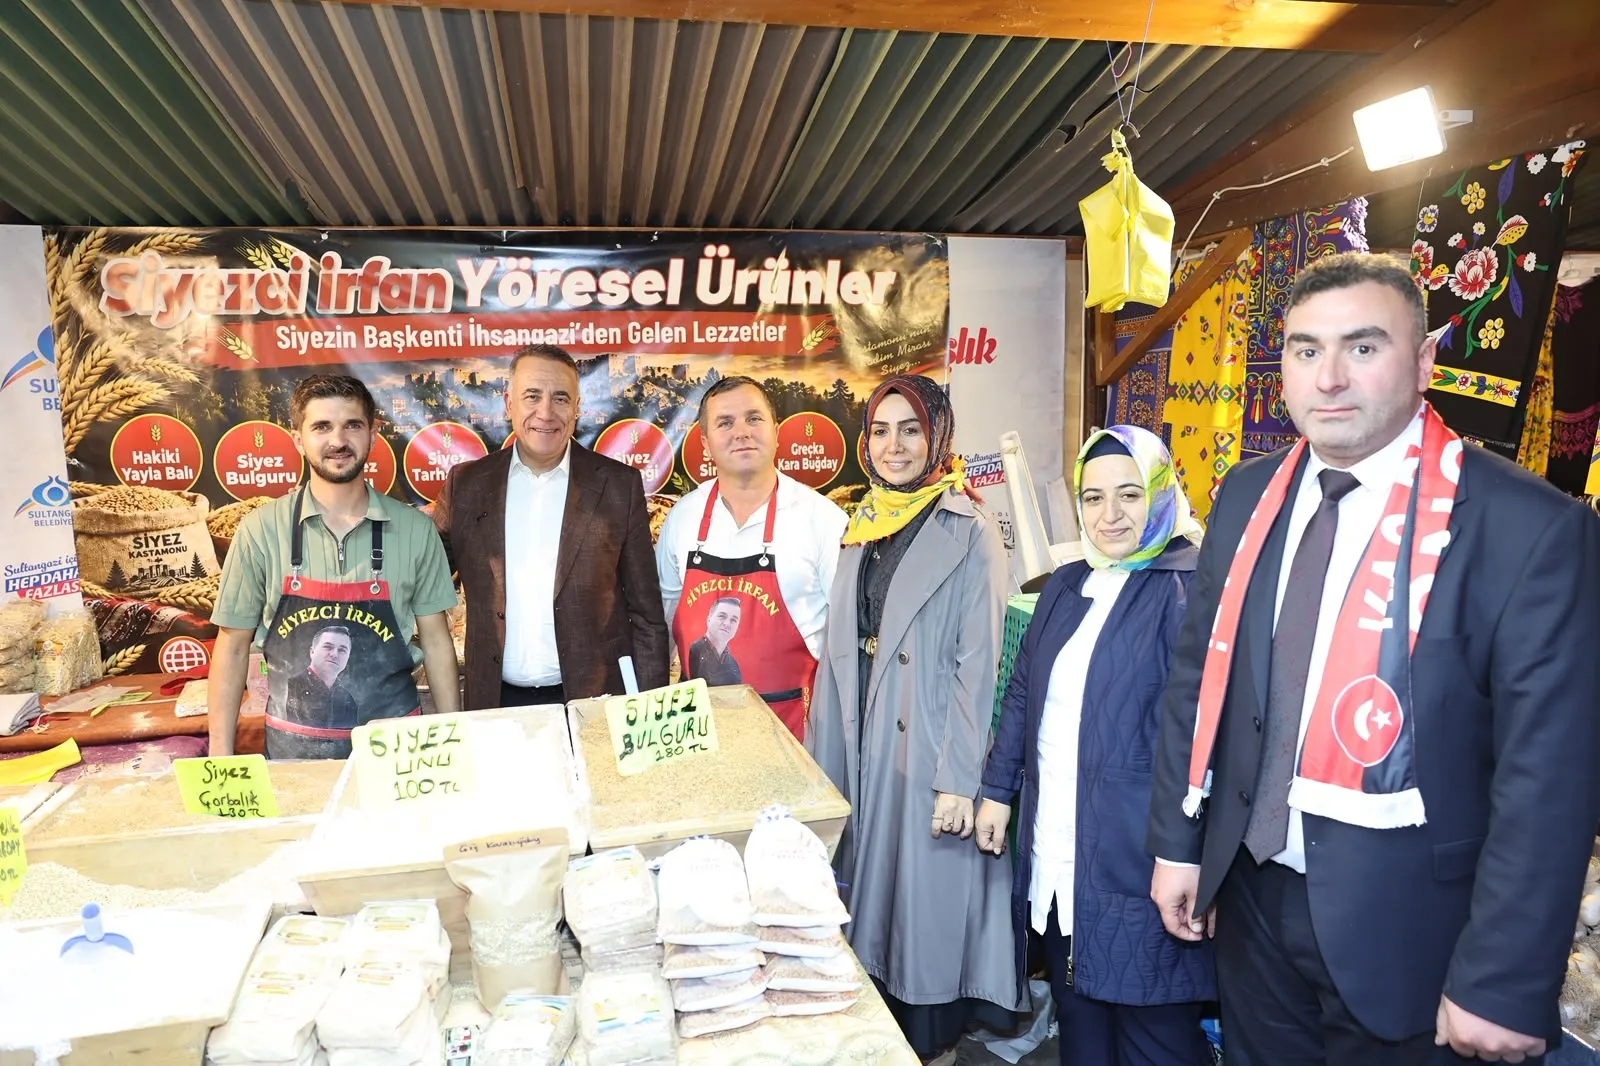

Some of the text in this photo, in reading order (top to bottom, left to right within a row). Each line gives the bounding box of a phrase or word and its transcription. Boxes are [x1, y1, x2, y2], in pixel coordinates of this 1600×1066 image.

[99, 250, 309, 329] Siyezci
[456, 256, 685, 308] Yöresel
[696, 243, 898, 305] Ürünler
[276, 325, 357, 355] Siyezin
[363, 323, 463, 353] Başkenti
[627, 321, 687, 344] Gelen
[693, 320, 787, 343] Lezzetler
[132, 448, 181, 465] Hakiki
[237, 453, 284, 472] Siyez
[778, 457, 838, 473] Kara Buğday
[121, 466, 194, 484] Yayla Balı
[226, 471, 297, 488] Bulguru
[132, 532, 182, 549] SİYEZ
[129, 545, 188, 559] KASTAMONU
[4, 556, 62, 577] Sultangazi
[686, 576, 779, 616] SİYEZCİ İRFAN
[277, 603, 395, 642] SİYEZCİ İRFAN
[619, 715, 708, 760] BULGURU
[689, 743, 708, 753] TL
[202, 760, 251, 787] Siyez
[396, 753, 451, 775] UNU
[394, 779, 435, 801] 100
